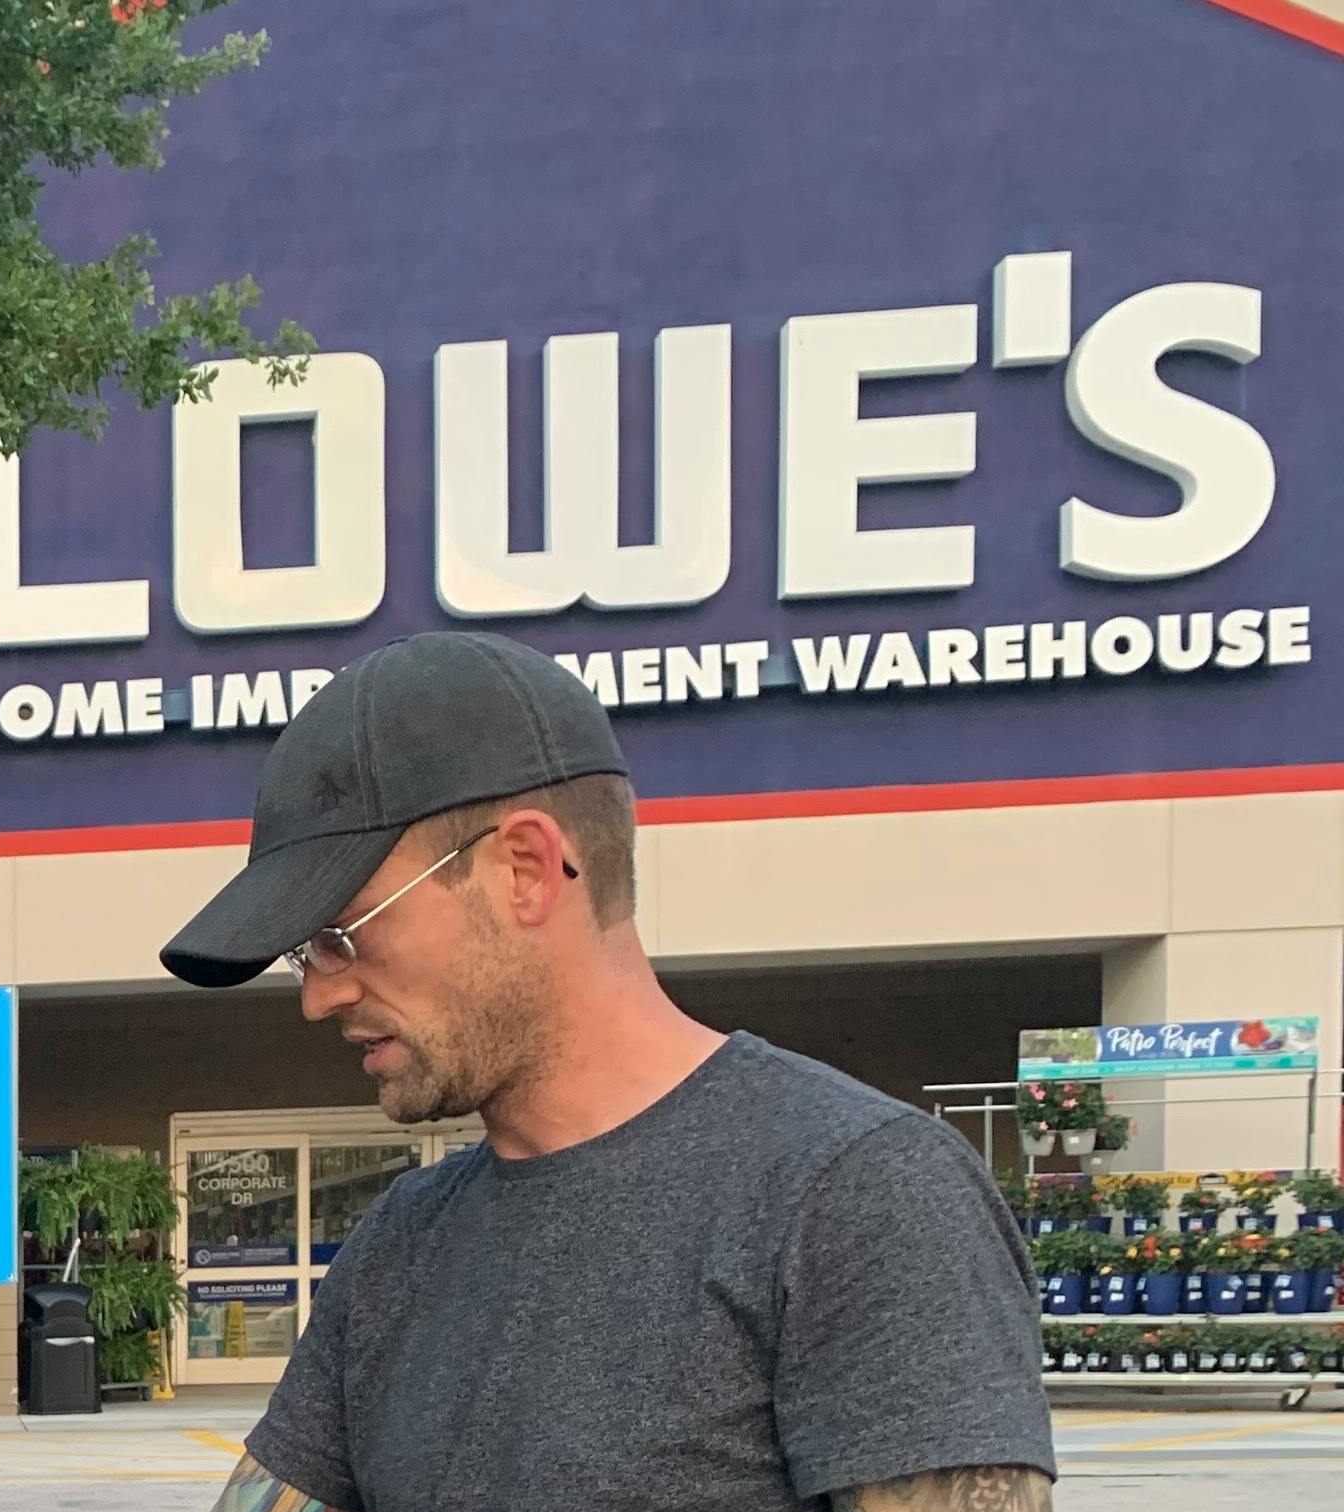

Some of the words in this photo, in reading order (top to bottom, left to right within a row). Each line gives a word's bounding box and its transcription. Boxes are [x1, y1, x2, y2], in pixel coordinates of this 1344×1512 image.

[190, 639, 769, 731] IMPMENT
[792, 605, 1312, 694] WAREHOUSE
[1106, 1026, 1156, 1056] Patio
[1159, 1024, 1223, 1057] Perfect
[197, 1176, 288, 1191] CORPORATE
[231, 1192, 254, 1206] DR
[256, 1283, 288, 1292] PLEASE
